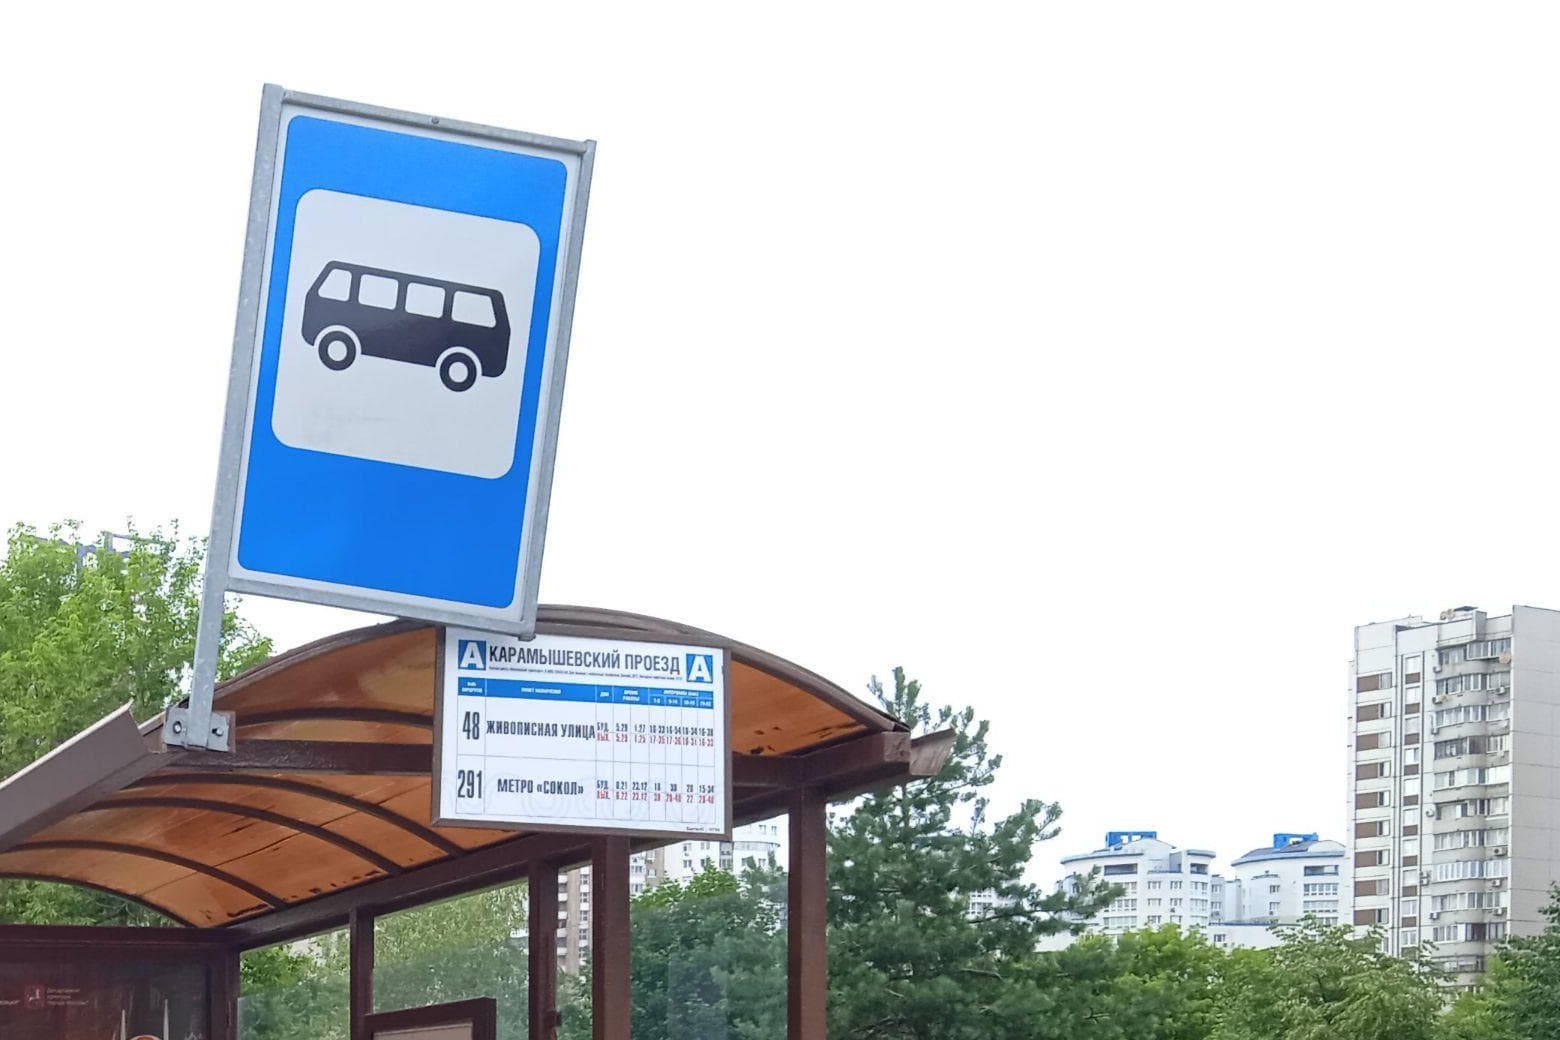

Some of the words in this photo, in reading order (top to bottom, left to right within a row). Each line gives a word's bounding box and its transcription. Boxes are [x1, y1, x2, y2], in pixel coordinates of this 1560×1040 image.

[489, 645, 620, 670] КАРАМЫШЕВСКИЙ
[624, 653, 680, 675] ПРОЕЗД
[462, 711, 480, 740] 48
[486, 720, 558, 737] ЖИВОПИСНАЯ
[560, 723, 596, 740] УЛИЦА
[457, 769, 482, 799] 291
[497, 778, 534, 793] МЕТРО
[536, 780, 584, 795] «СОКОЛ»
